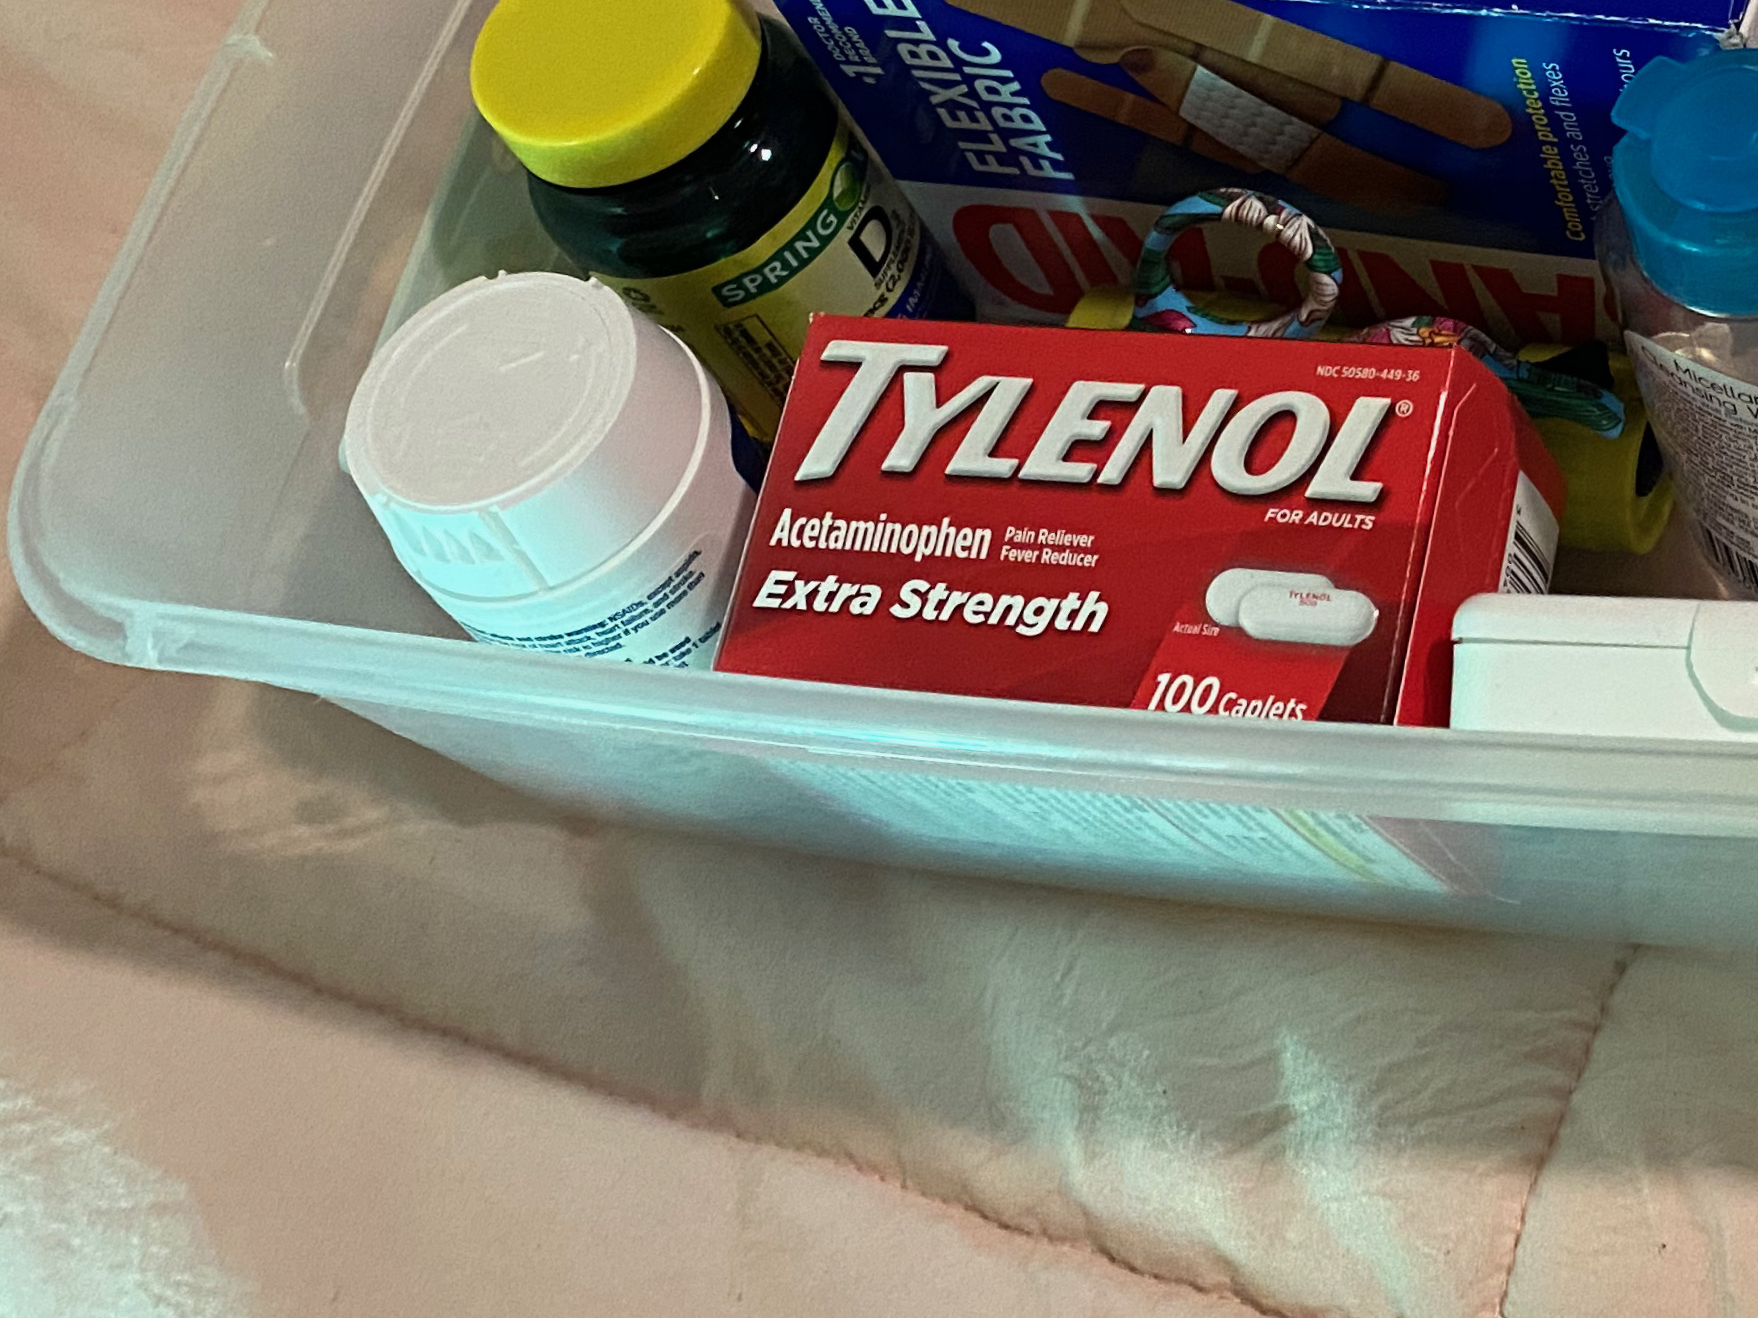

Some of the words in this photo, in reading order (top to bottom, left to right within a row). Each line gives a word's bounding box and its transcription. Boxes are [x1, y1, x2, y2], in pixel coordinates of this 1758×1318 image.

[807, 15, 844, 62] DOCTOR
[947, 37, 1075, 181] FABRIC
[1511, 56, 1553, 135] protection
[1548, 61, 1570, 109] flexes
[1536, 135, 1585, 242] Comfortable
[721, 208, 838, 302] SPRING
[769, 508, 993, 563] Acetaminophen
[1004, 526, 1036, 544] Pain
[1037, 529, 1096, 549] Reliever
[1265, 507, 1303, 525] FOR
[1305, 510, 1376, 530] ADULTS
[999, 546, 1039, 565] Fever
[1040, 548, 1099, 568] Reducer
[752, 570, 883, 616] Extra
[888, 579, 1110, 636] Strength
[1147, 672, 1221, 714] 100
[1218, 688, 1309, 720] Caplets
